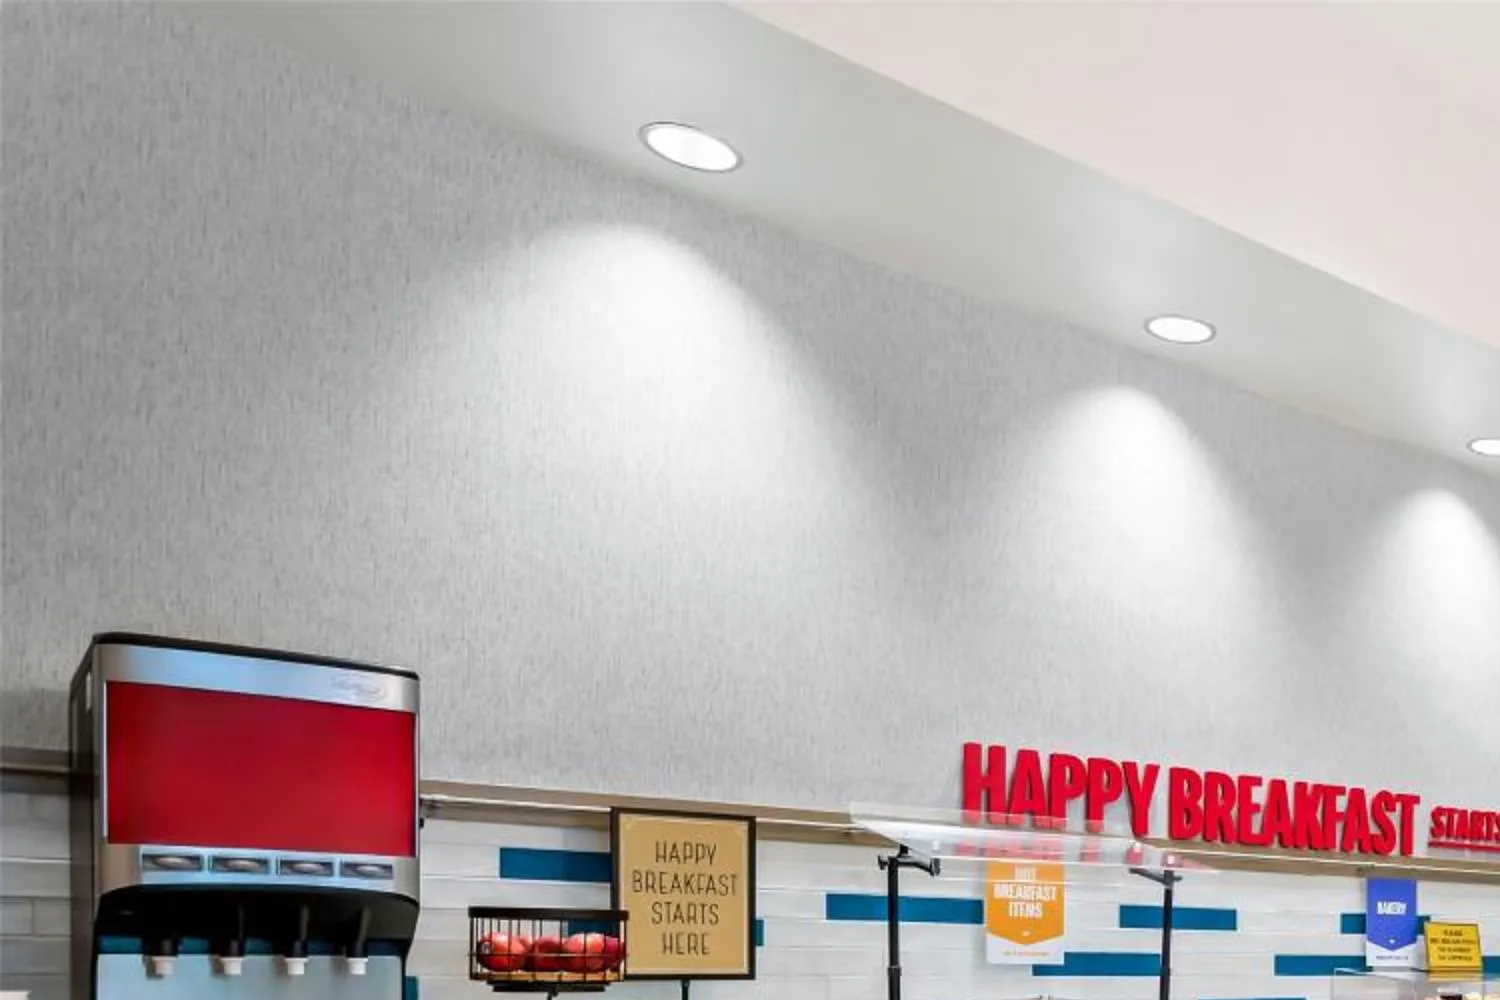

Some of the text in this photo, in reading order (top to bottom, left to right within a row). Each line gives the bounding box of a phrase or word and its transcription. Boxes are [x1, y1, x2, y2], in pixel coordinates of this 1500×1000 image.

[961, 742, 1160, 838] HAPPY
[1168, 767, 1421, 857] BREAKFAST
[655, 840, 717, 866] HAPPY
[631, 869, 738, 897] BREAKFAST
[991, 882, 1057, 901] BREAKFAST
[651, 901, 720, 926] STARTS
[1008, 901, 1044, 918] ITEMS
[661, 932, 711, 956] HERE
